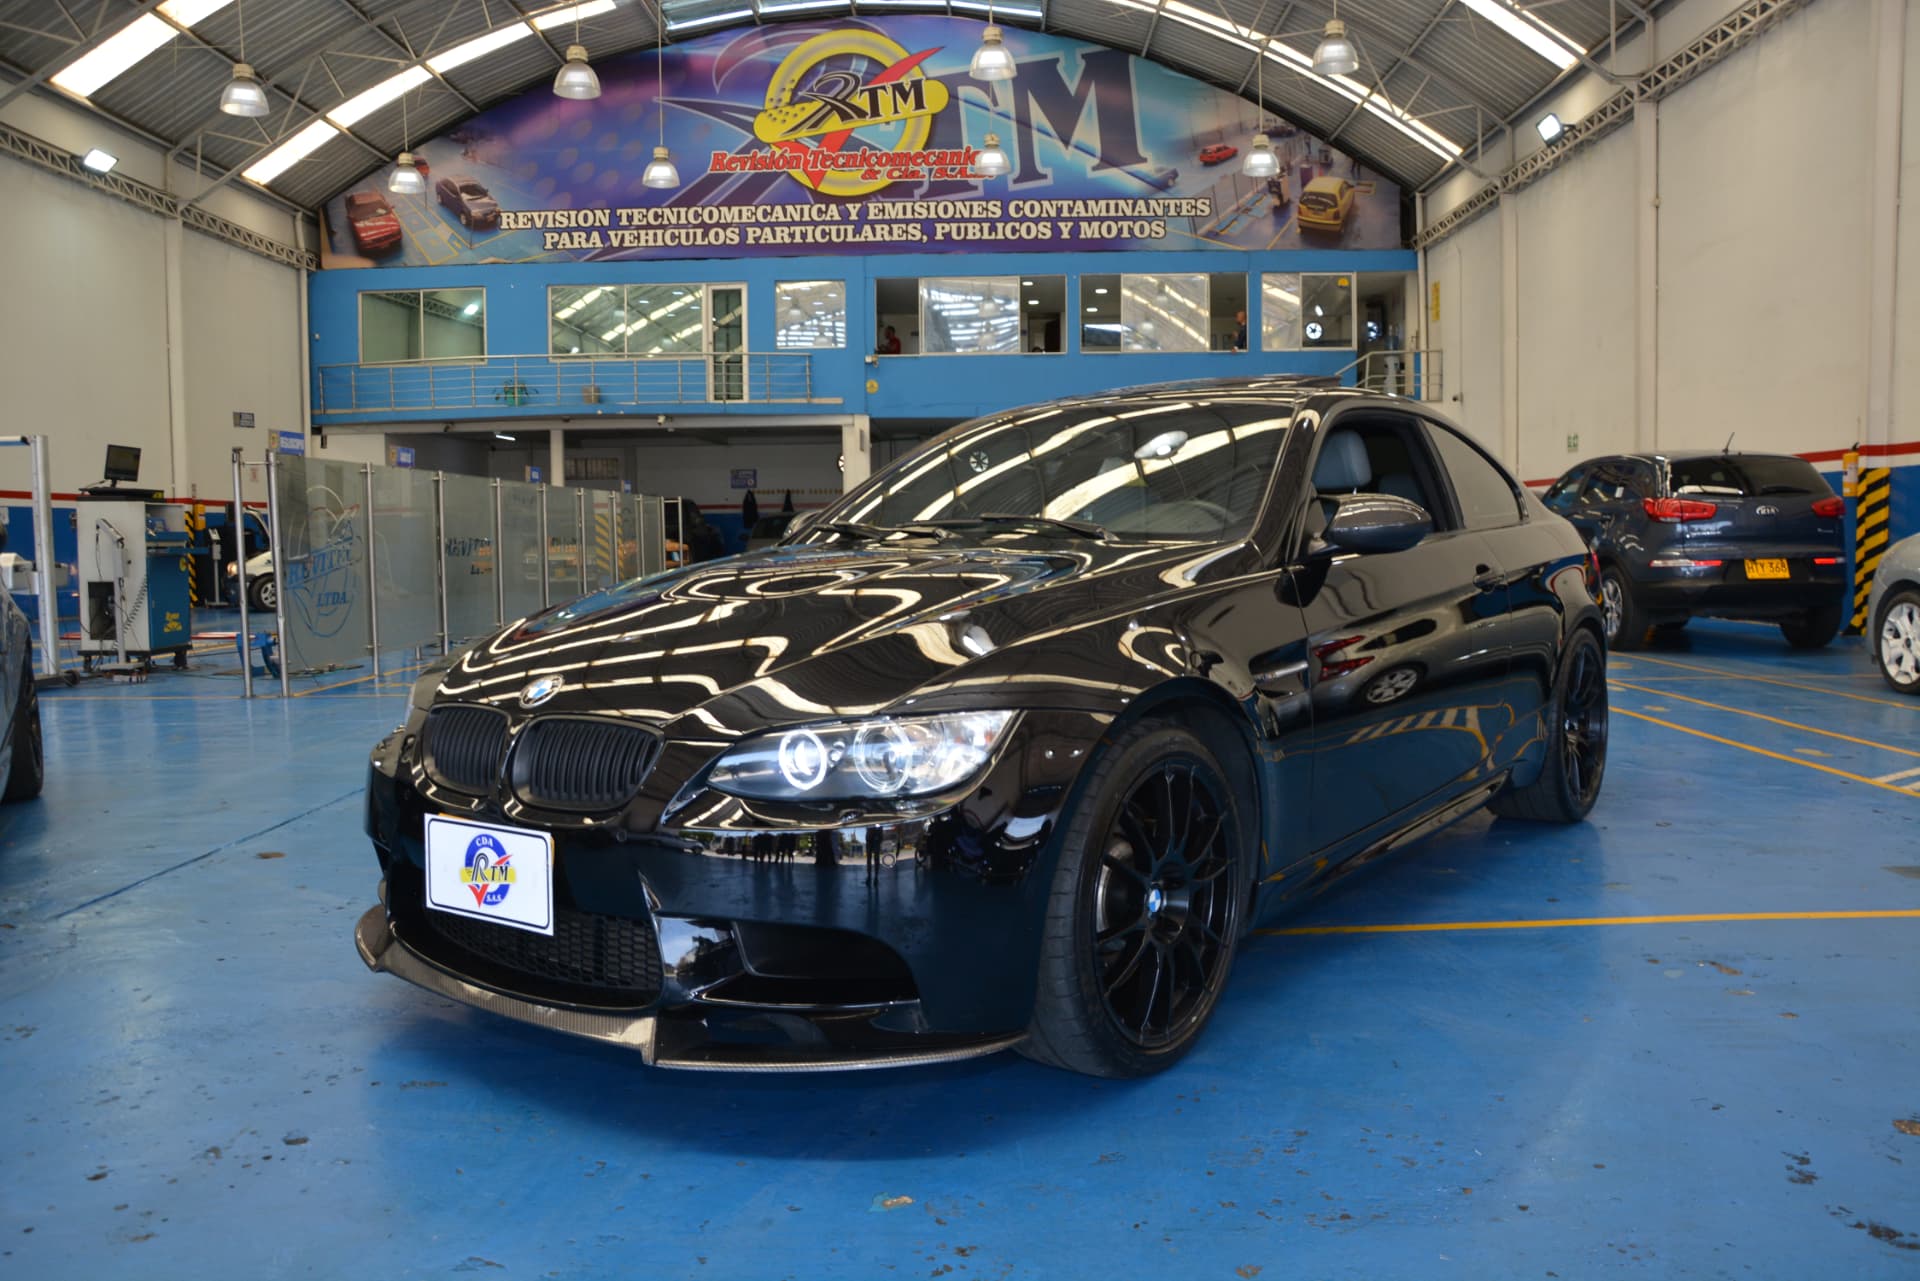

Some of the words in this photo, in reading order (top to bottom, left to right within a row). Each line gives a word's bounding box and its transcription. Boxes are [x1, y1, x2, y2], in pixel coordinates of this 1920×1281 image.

[779, 72, 927, 136] RTM
[710, 146, 803, 172] Revisión
[808, 145, 981, 171] Tecnicomecanic
[861, 167, 881, 180] &
[500, 208, 611, 230] REVISION
[616, 203, 842, 227] TECNICOMECANICA
[847, 202, 862, 220] Y
[867, 200, 1002, 220] EMISIONES
[1008, 198, 1211, 219] CONTAMINANTES
[544, 231, 604, 250] PARA
[608, 227, 741, 248] VEHICULOS
[745, 222, 928, 243] PARTICULARES,
[934, 221, 1052, 241] PUBLICOS
[1057, 221, 1076, 240] Y
[1079, 219, 1166, 239] MOTOS
[475, 836, 494, 848] CDA
[471, 852, 508, 882] RTM
